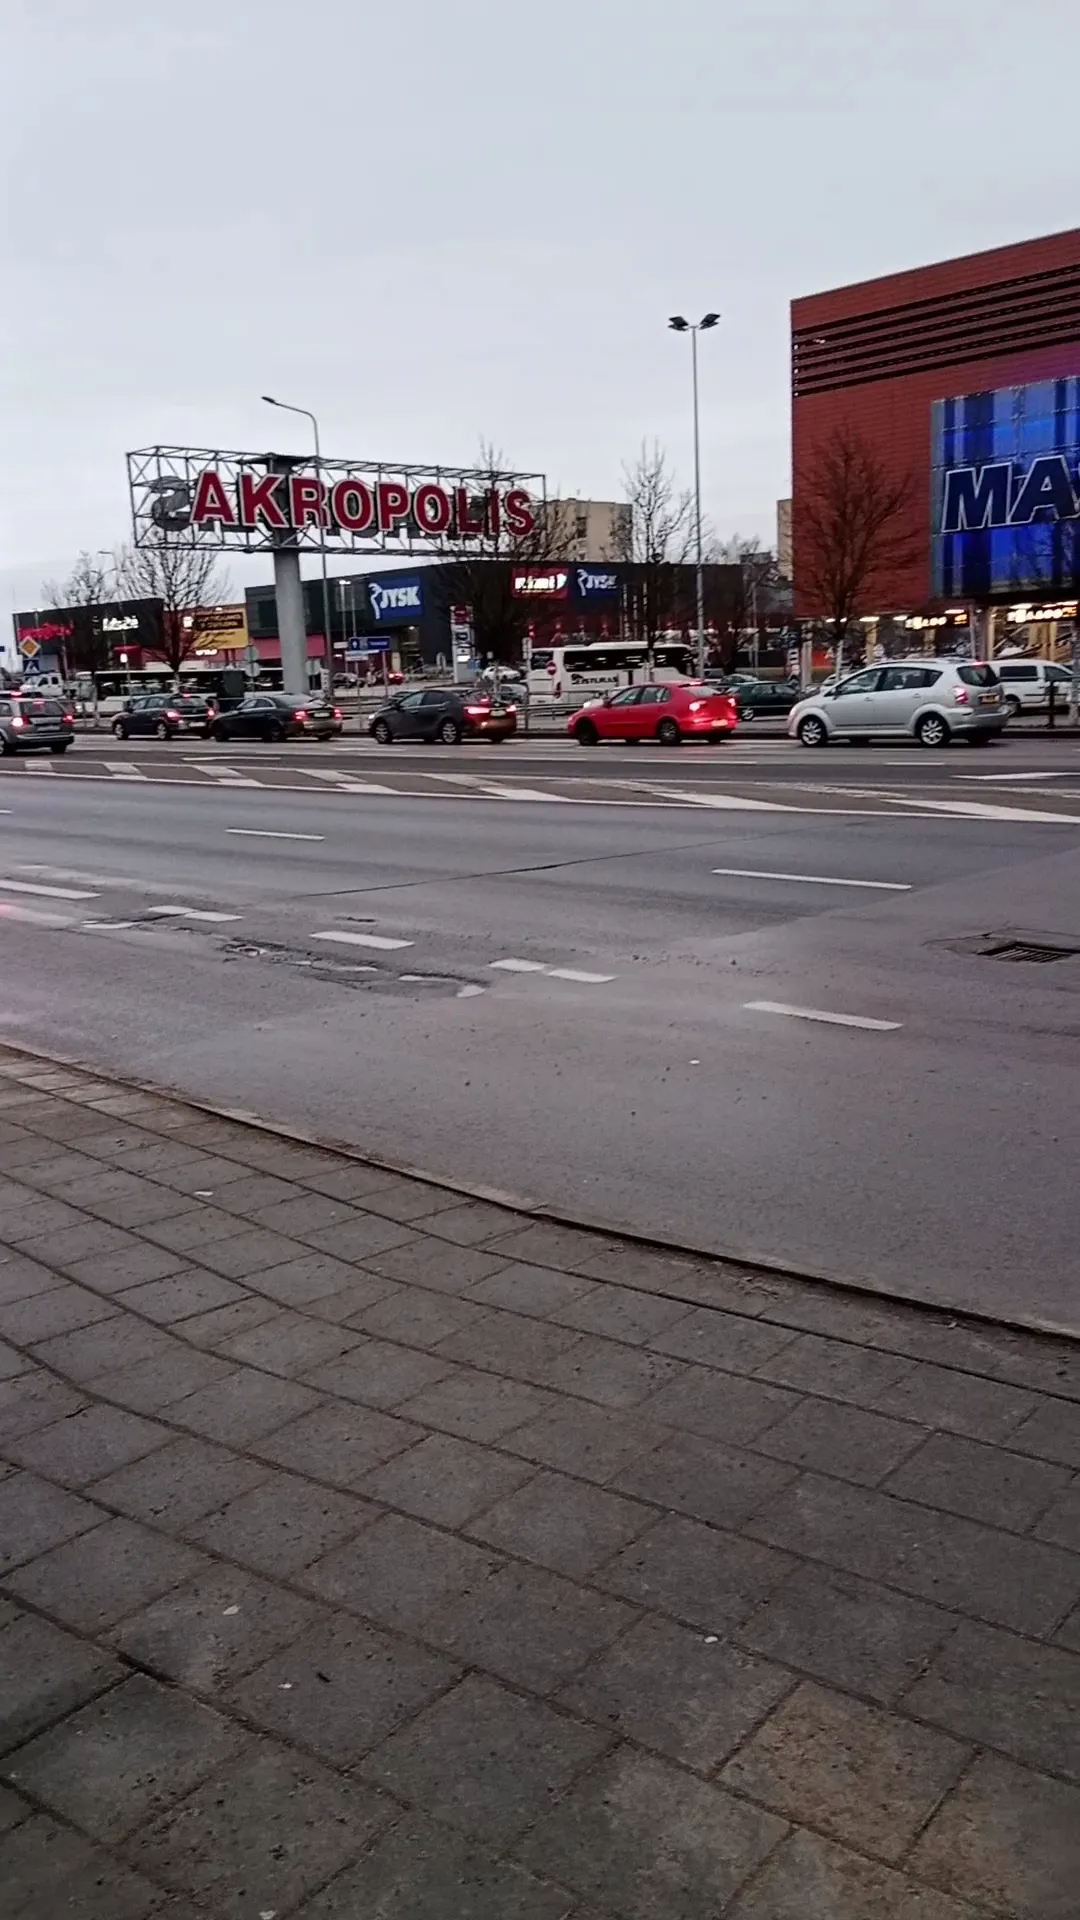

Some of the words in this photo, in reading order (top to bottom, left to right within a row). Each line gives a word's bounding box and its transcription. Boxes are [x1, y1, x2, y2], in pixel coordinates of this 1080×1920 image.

[190, 470, 536, 538] AKROPOLIS
[941, 454, 1080, 533] MA
[380, 586, 421, 609] JYSK
